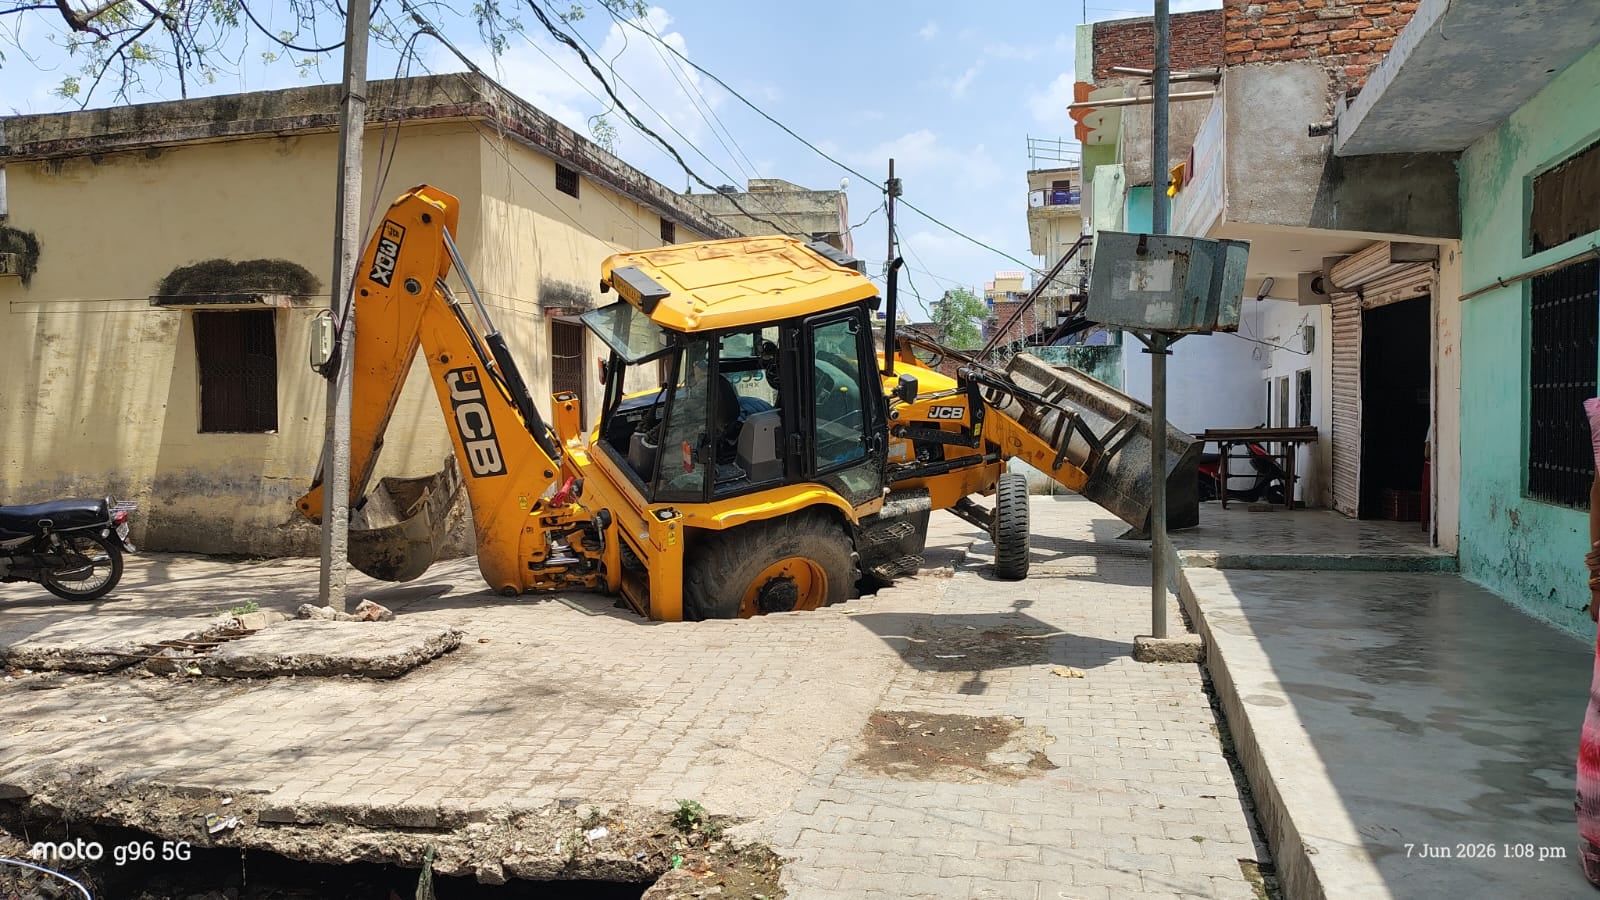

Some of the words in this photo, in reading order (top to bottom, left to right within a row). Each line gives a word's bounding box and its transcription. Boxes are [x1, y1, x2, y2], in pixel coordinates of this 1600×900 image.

[371, 239, 398, 285] 3DX
[446, 372, 502, 475] JCB
[928, 406, 964, 419] JCB
